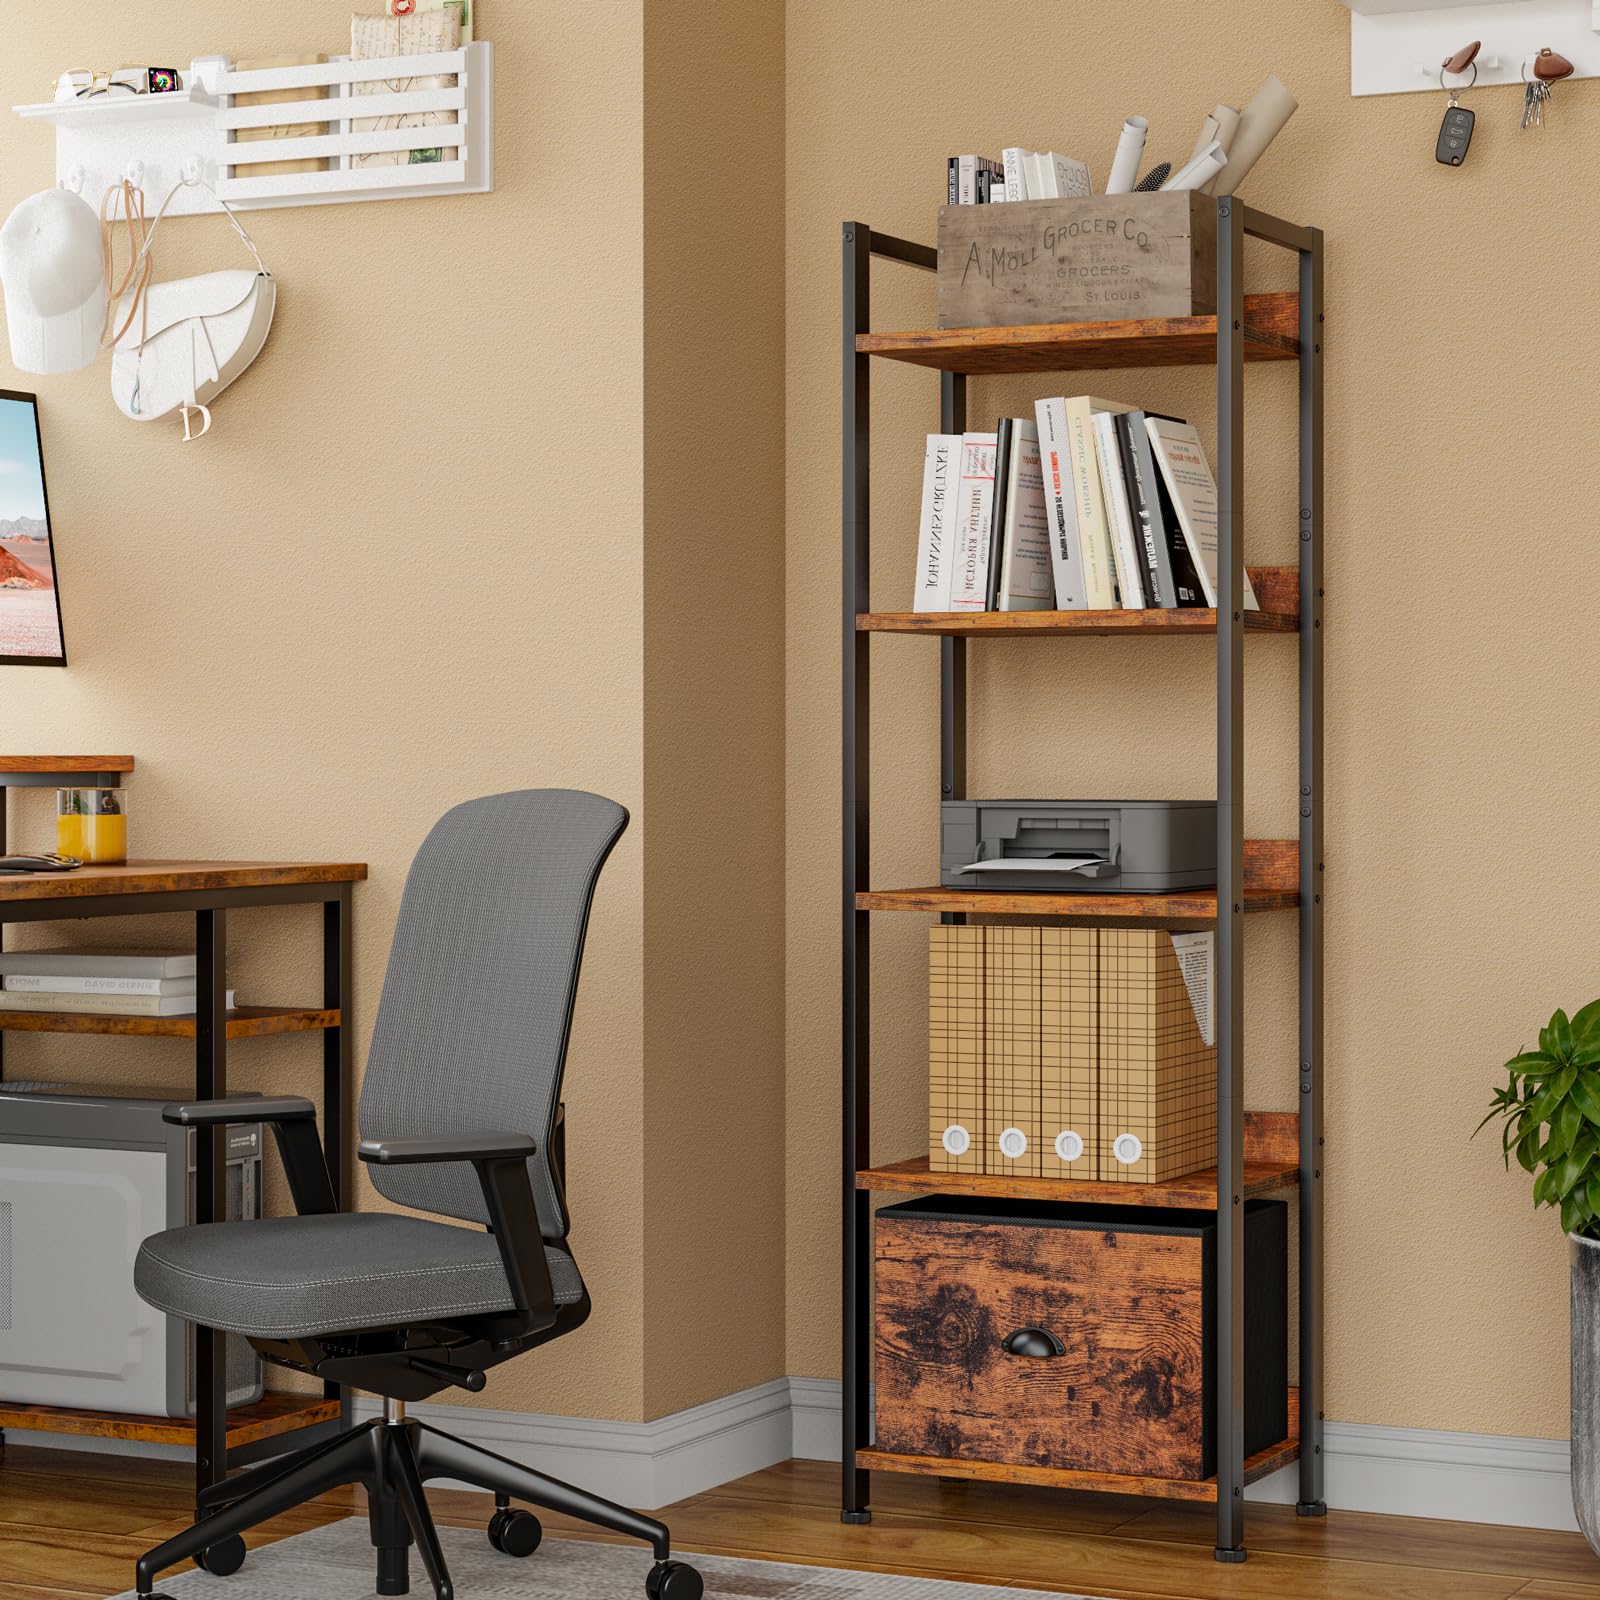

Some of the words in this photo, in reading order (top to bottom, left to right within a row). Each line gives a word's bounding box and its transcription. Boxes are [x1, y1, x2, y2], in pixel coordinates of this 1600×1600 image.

[992, 247, 1039, 287] MOLL
[1044, 219, 1117, 256] GROCER
[1104, 290, 1141, 301] LOUIS
